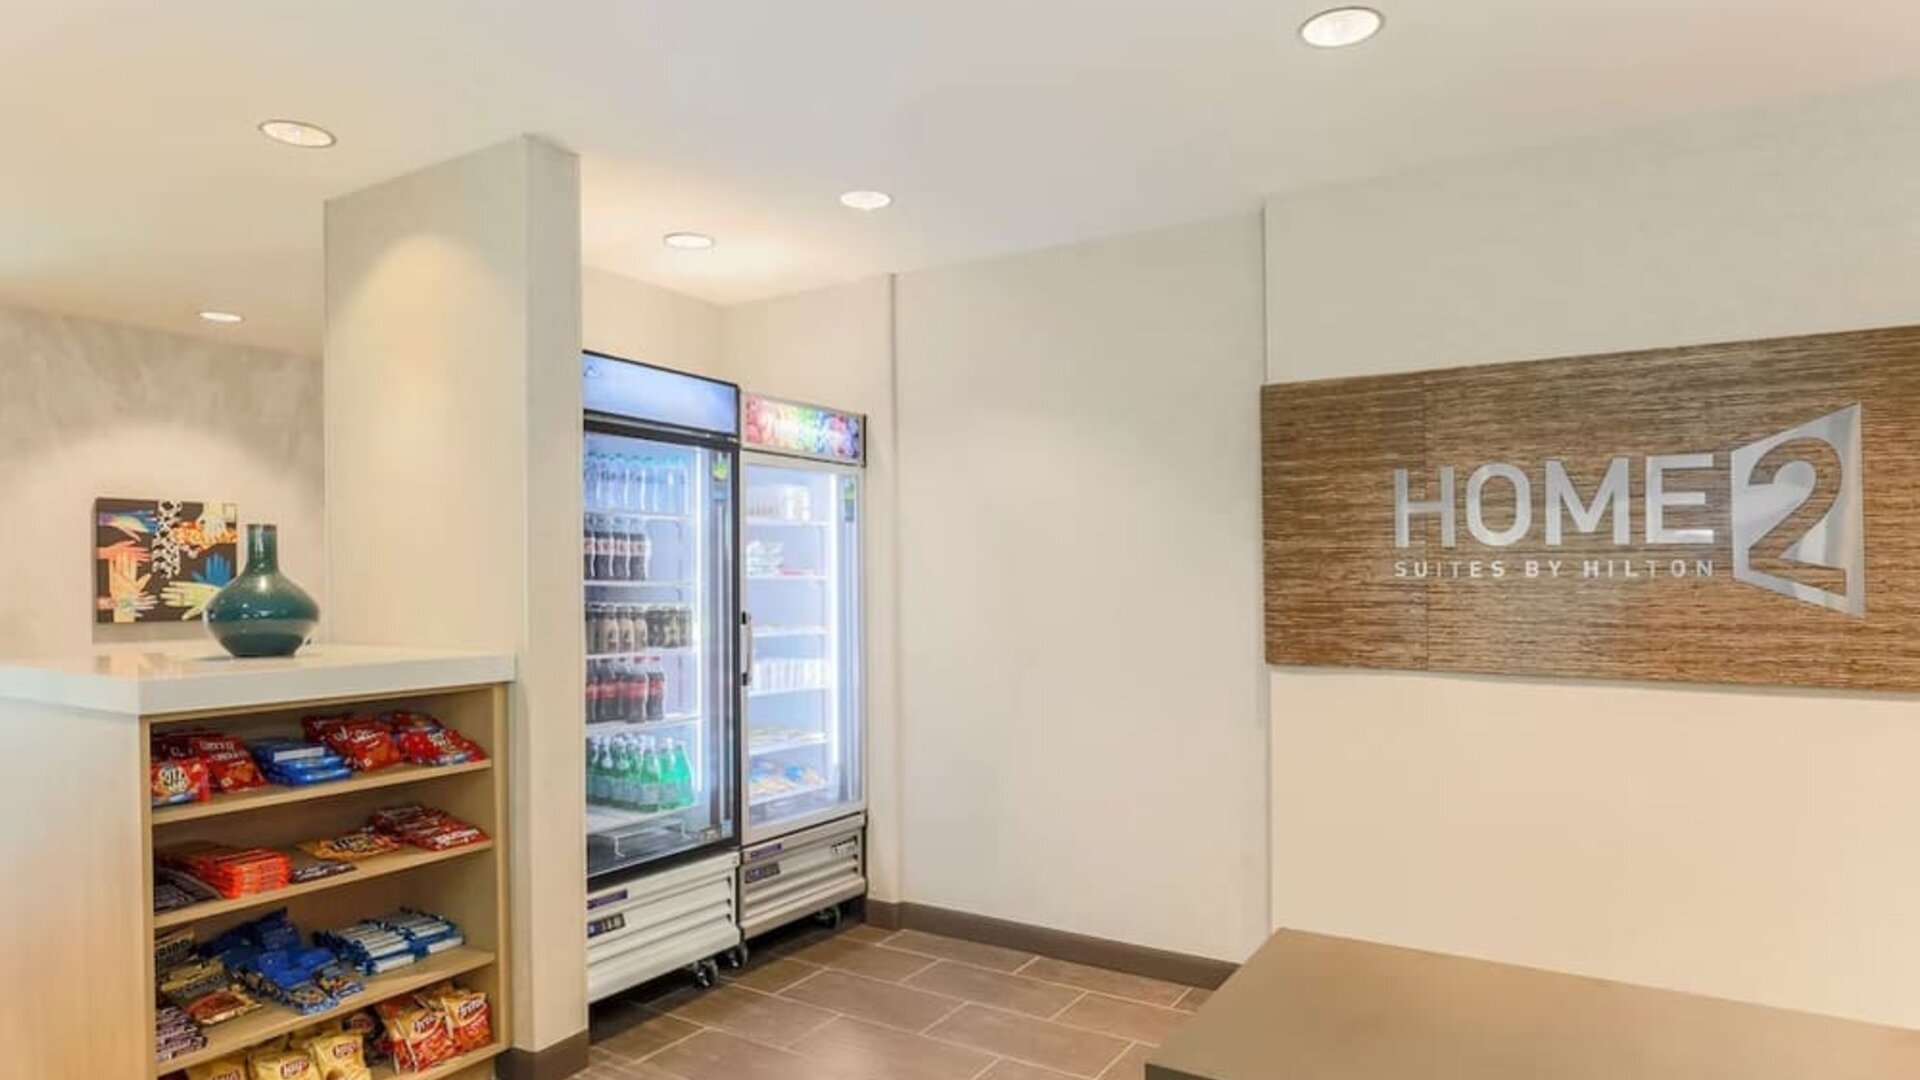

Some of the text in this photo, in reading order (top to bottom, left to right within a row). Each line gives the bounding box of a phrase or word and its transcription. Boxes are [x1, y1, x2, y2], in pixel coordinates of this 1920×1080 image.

[1394, 453, 1714, 548] HOME
[1394, 559, 1713, 578] SUITES BY HILTON
